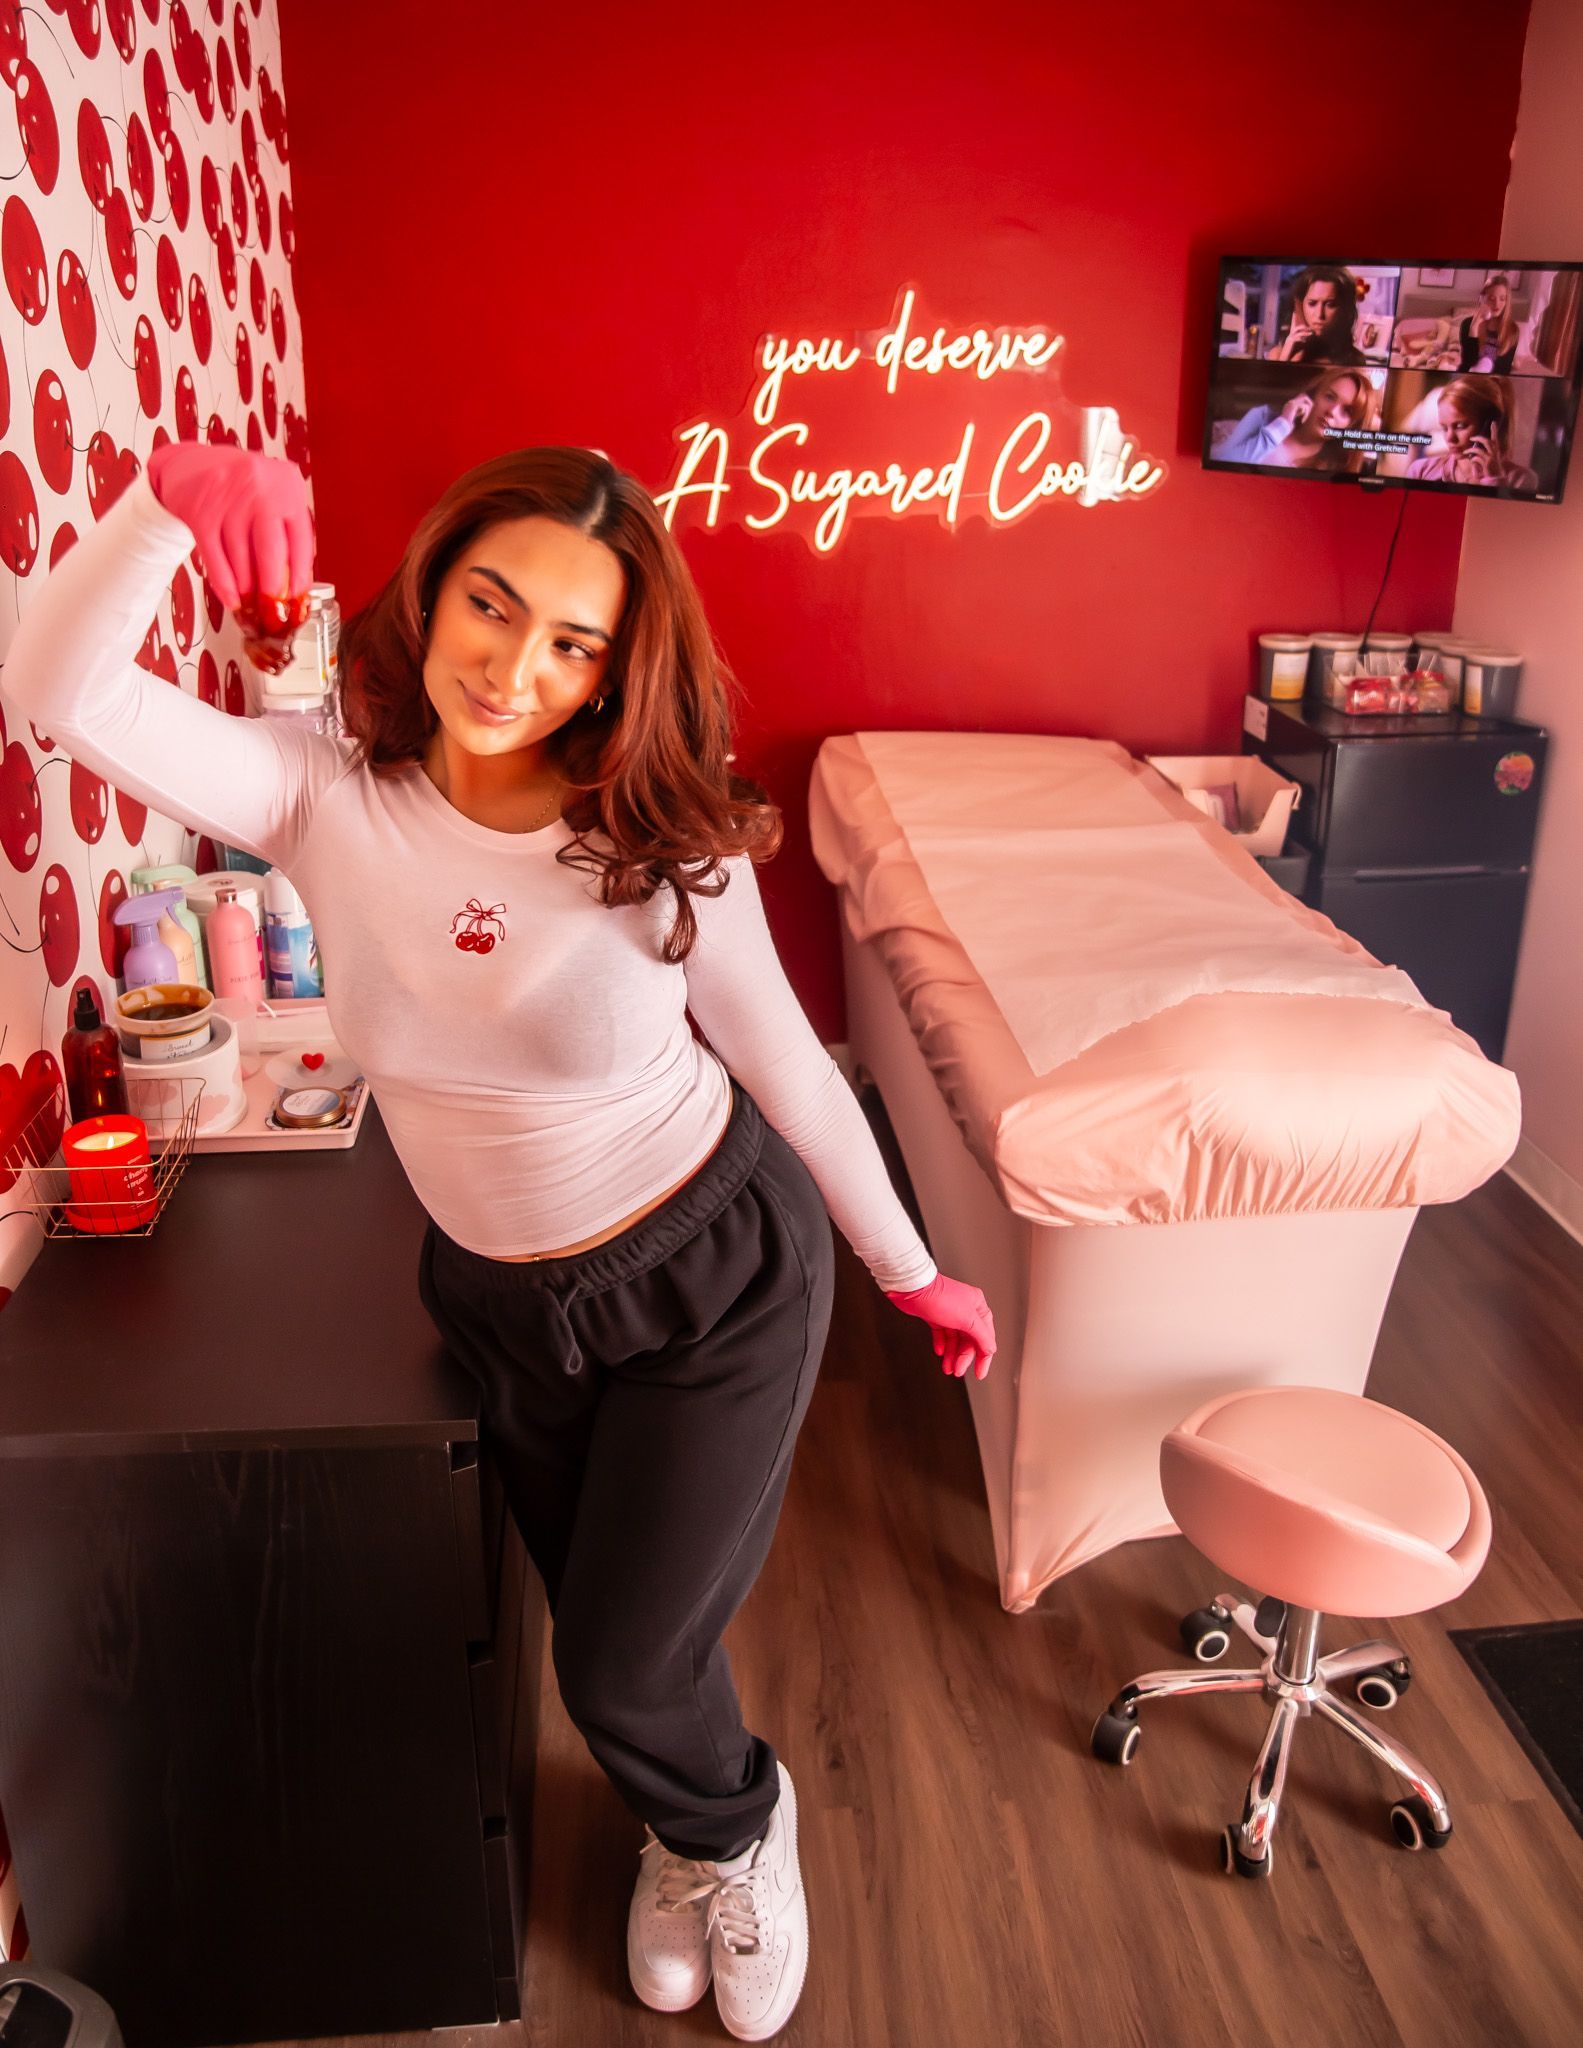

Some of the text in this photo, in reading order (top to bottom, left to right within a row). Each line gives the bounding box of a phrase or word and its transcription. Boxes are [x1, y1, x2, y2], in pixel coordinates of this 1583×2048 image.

[754, 290, 1064, 426] you deserve
[1343, 430, 1361, 439] Hold
[1387, 434, 1398, 442] on
[1398, 434, 1411, 443] the
[1411, 435, 1432, 445] other
[1343, 440, 1357, 449] line
[1357, 442, 1373, 451] with
[652, 406, 1164, 553] A Sugared Cookie
